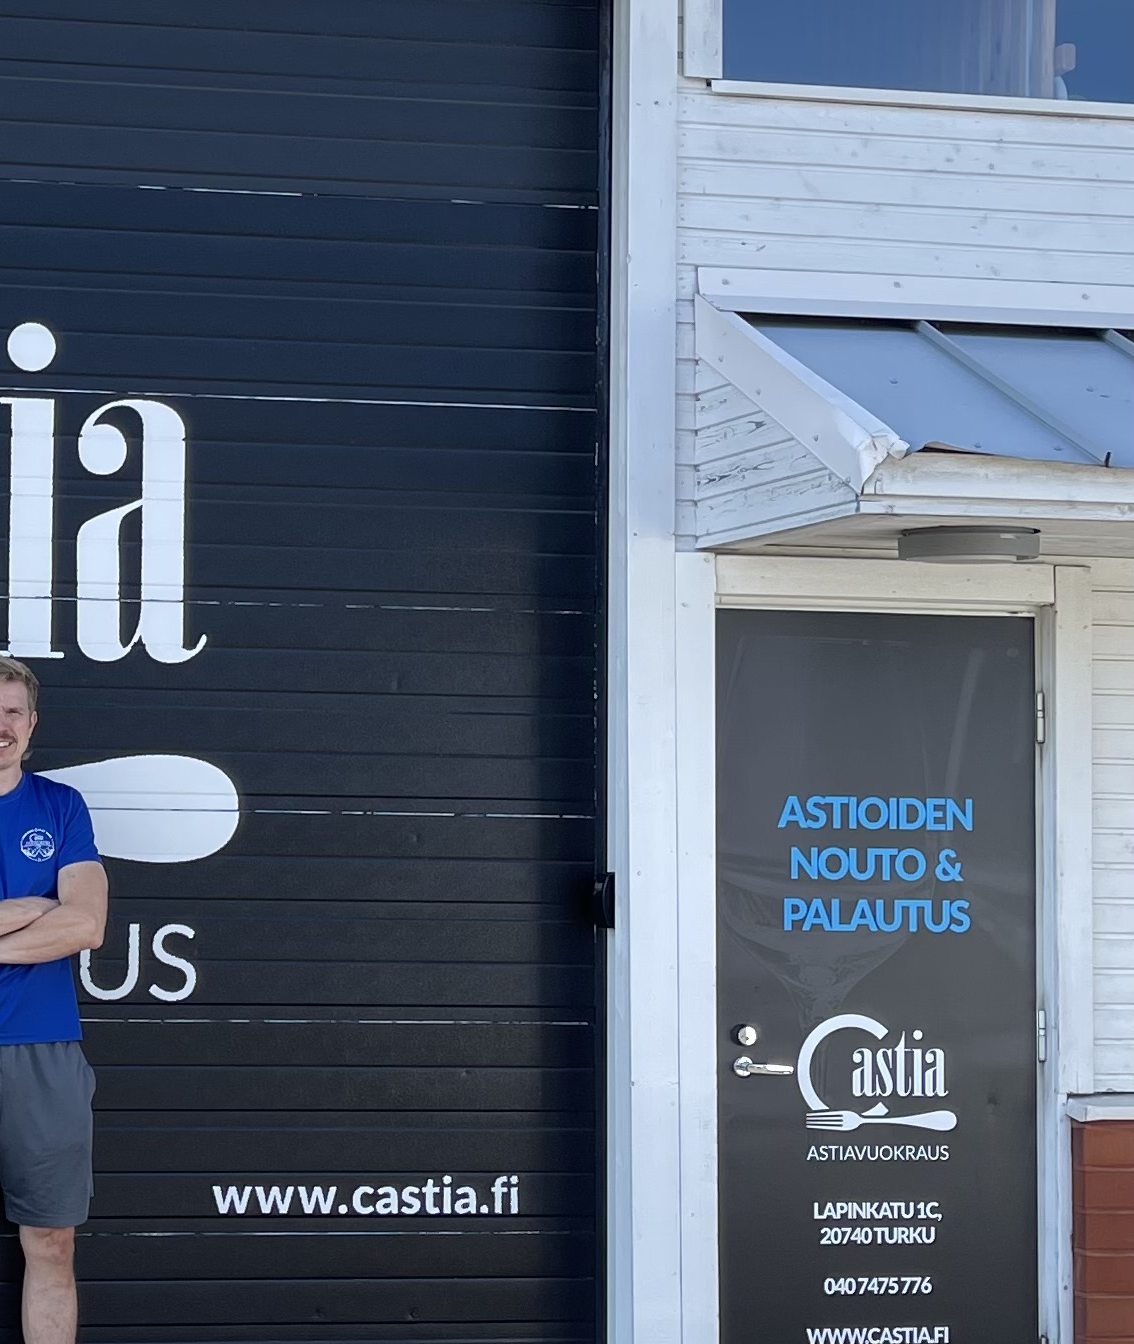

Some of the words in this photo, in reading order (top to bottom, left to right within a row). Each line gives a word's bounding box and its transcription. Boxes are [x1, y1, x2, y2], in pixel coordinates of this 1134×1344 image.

[777, 795, 973, 831] ASTIOIDEN
[790, 846, 927, 882] NOUTO
[935, 848, 964, 882] &
[783, 897, 971, 933] PALAUTUS
[797, 1013, 949, 1117] Castia
[806, 1145, 950, 1161] ASTIAVUOKRAUS
[212, 1174, 519, 1215] www.castia.fi
[813, 1201, 915, 1220] LAPINKATU
[916, 1201, 943, 1222] 1C,
[819, 1227, 873, 1245] 20740
[873, 1226, 936, 1244] TURKU
